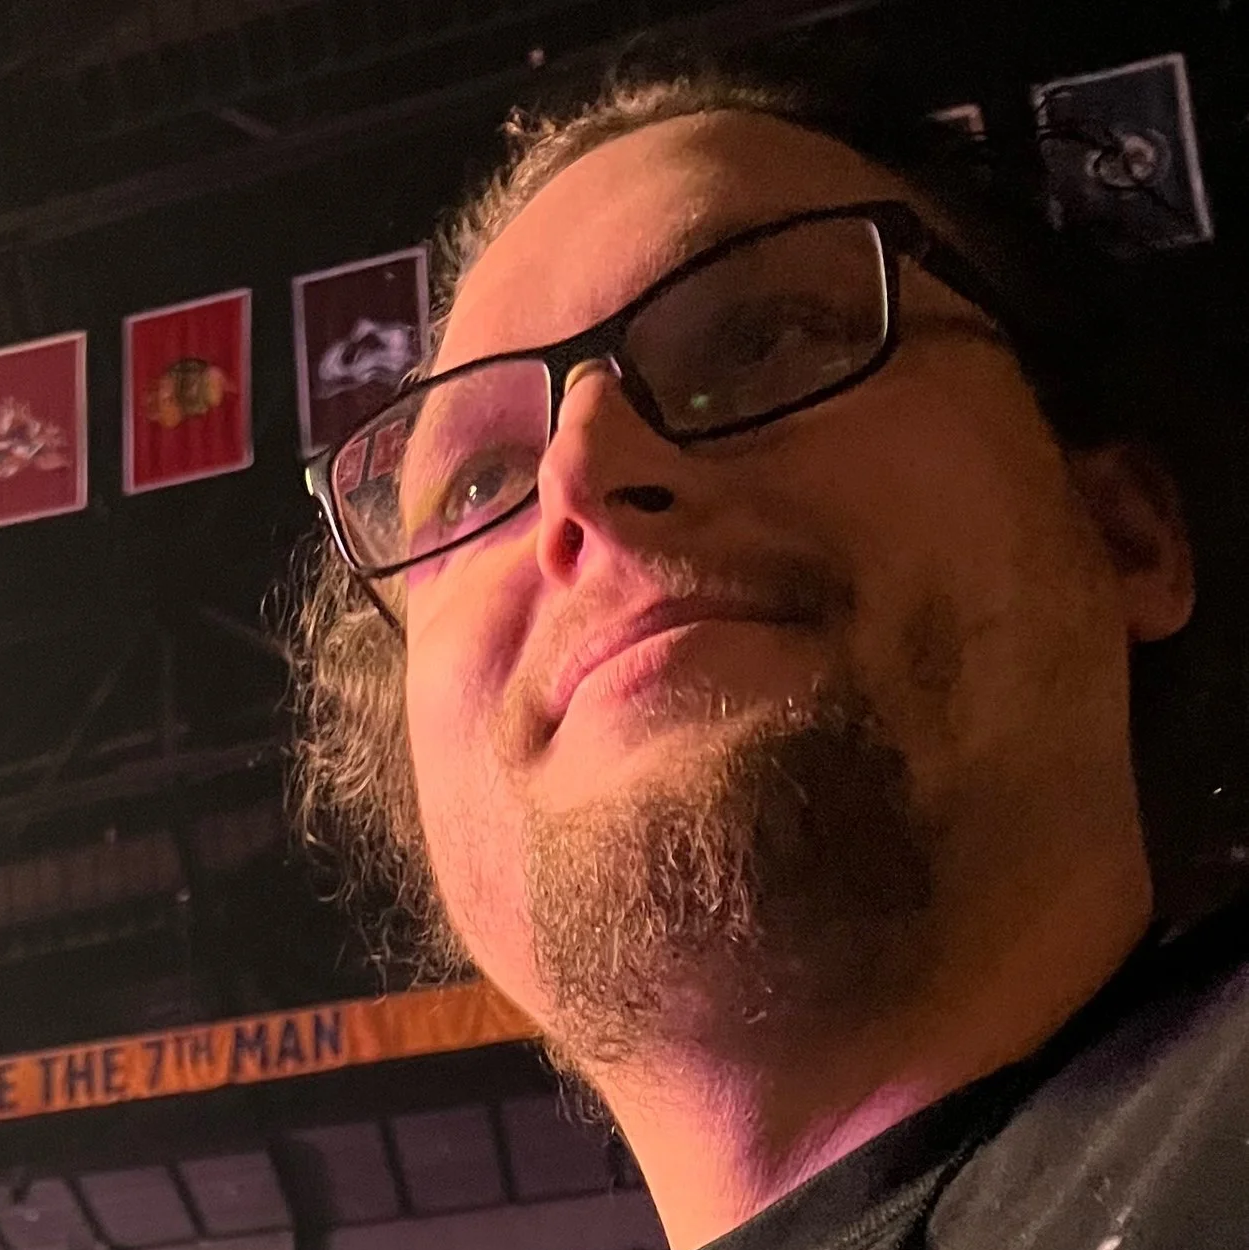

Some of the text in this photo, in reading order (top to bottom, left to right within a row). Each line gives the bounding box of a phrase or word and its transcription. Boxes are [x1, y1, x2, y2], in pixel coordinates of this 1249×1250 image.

[40, 1046, 126, 1105] THE
[143, 1027, 214, 1089] 7TH
[231, 1011, 343, 1074] MAN
